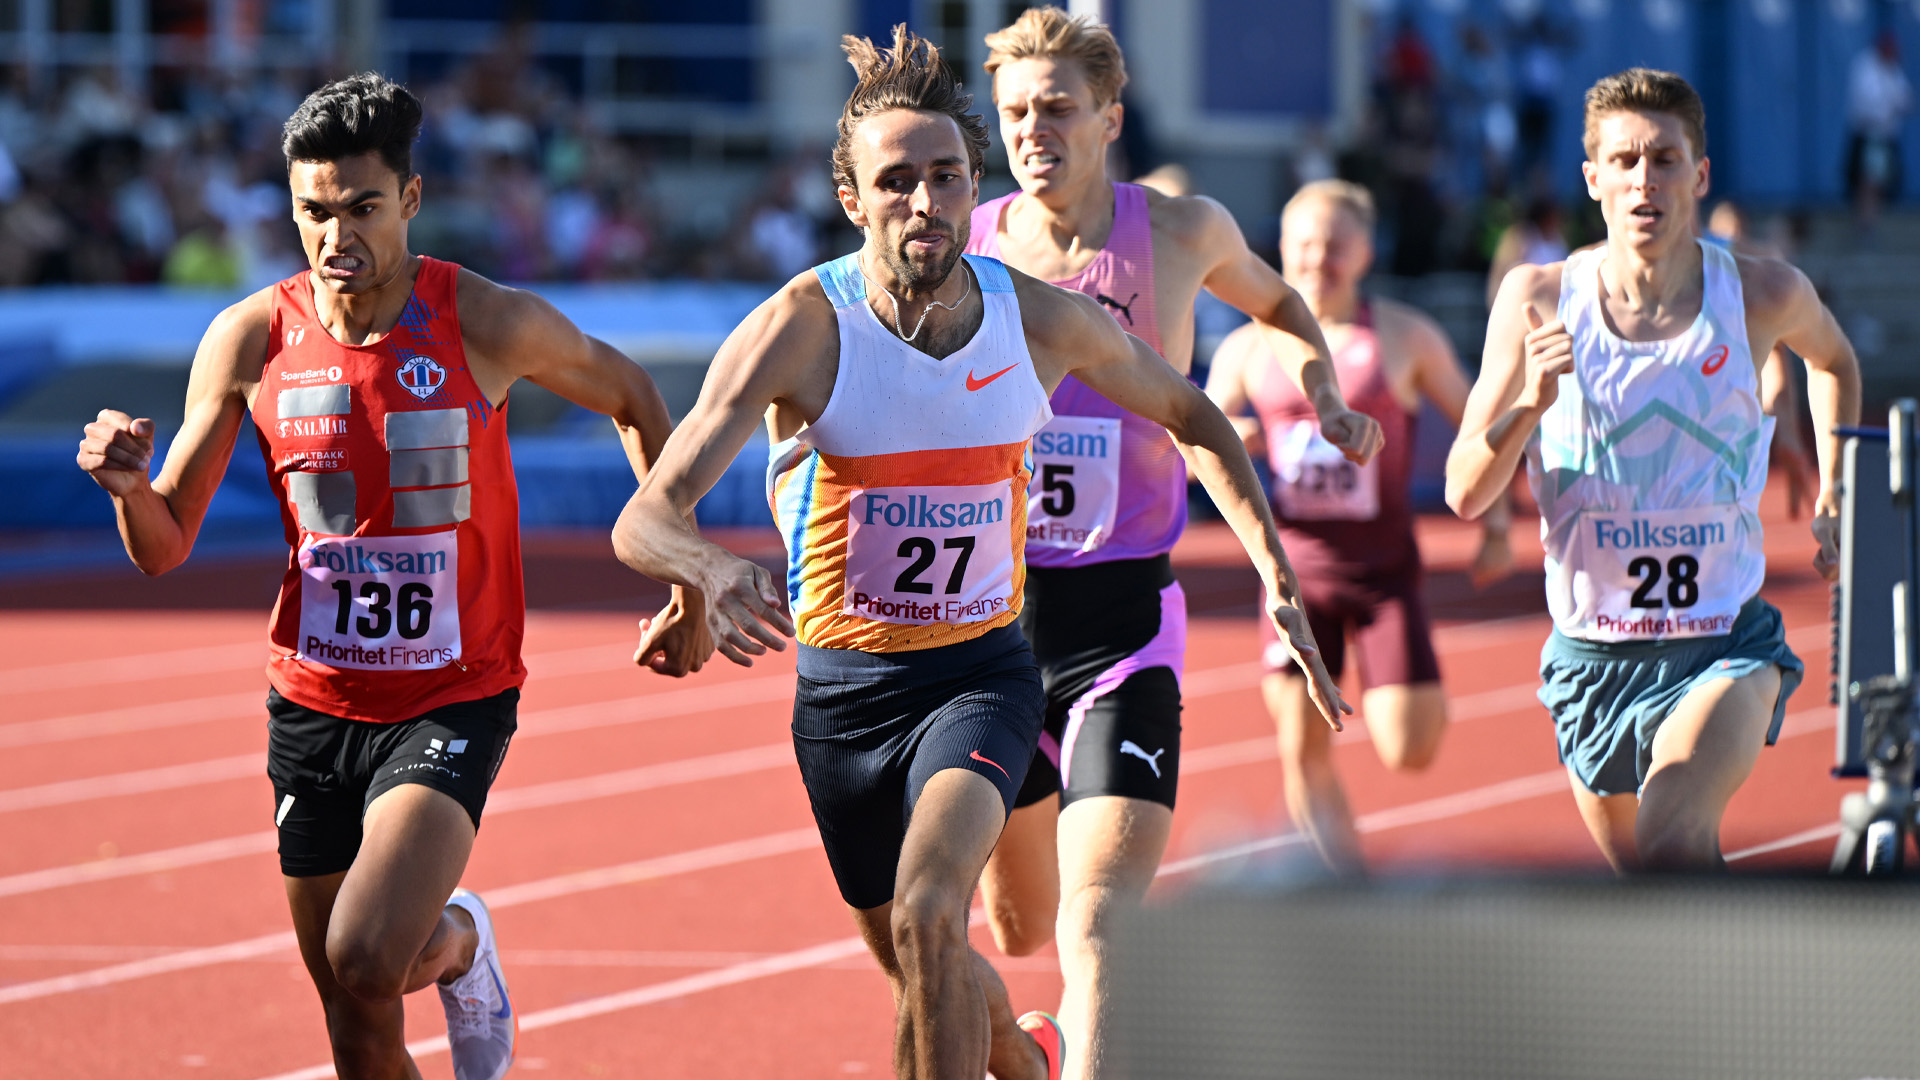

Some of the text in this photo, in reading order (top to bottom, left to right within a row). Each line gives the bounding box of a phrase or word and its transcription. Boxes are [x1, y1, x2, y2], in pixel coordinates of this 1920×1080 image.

[280, 368, 327, 381] SpareBank
[293, 450, 344, 461] HALTBAKK
[863, 494, 1003, 529] Folksam
[1595, 519, 1725, 550] Folksam
[310, 544, 446, 575] Folksam
[894, 536, 976, 595] 27
[1627, 554, 1699, 609] 28
[331, 579, 434, 640] 136
[853, 592, 1004, 621] Prioritet Finans
[1597, 615, 1673, 634] Prioritet
[306, 635, 453, 666] Prioritet Finans
